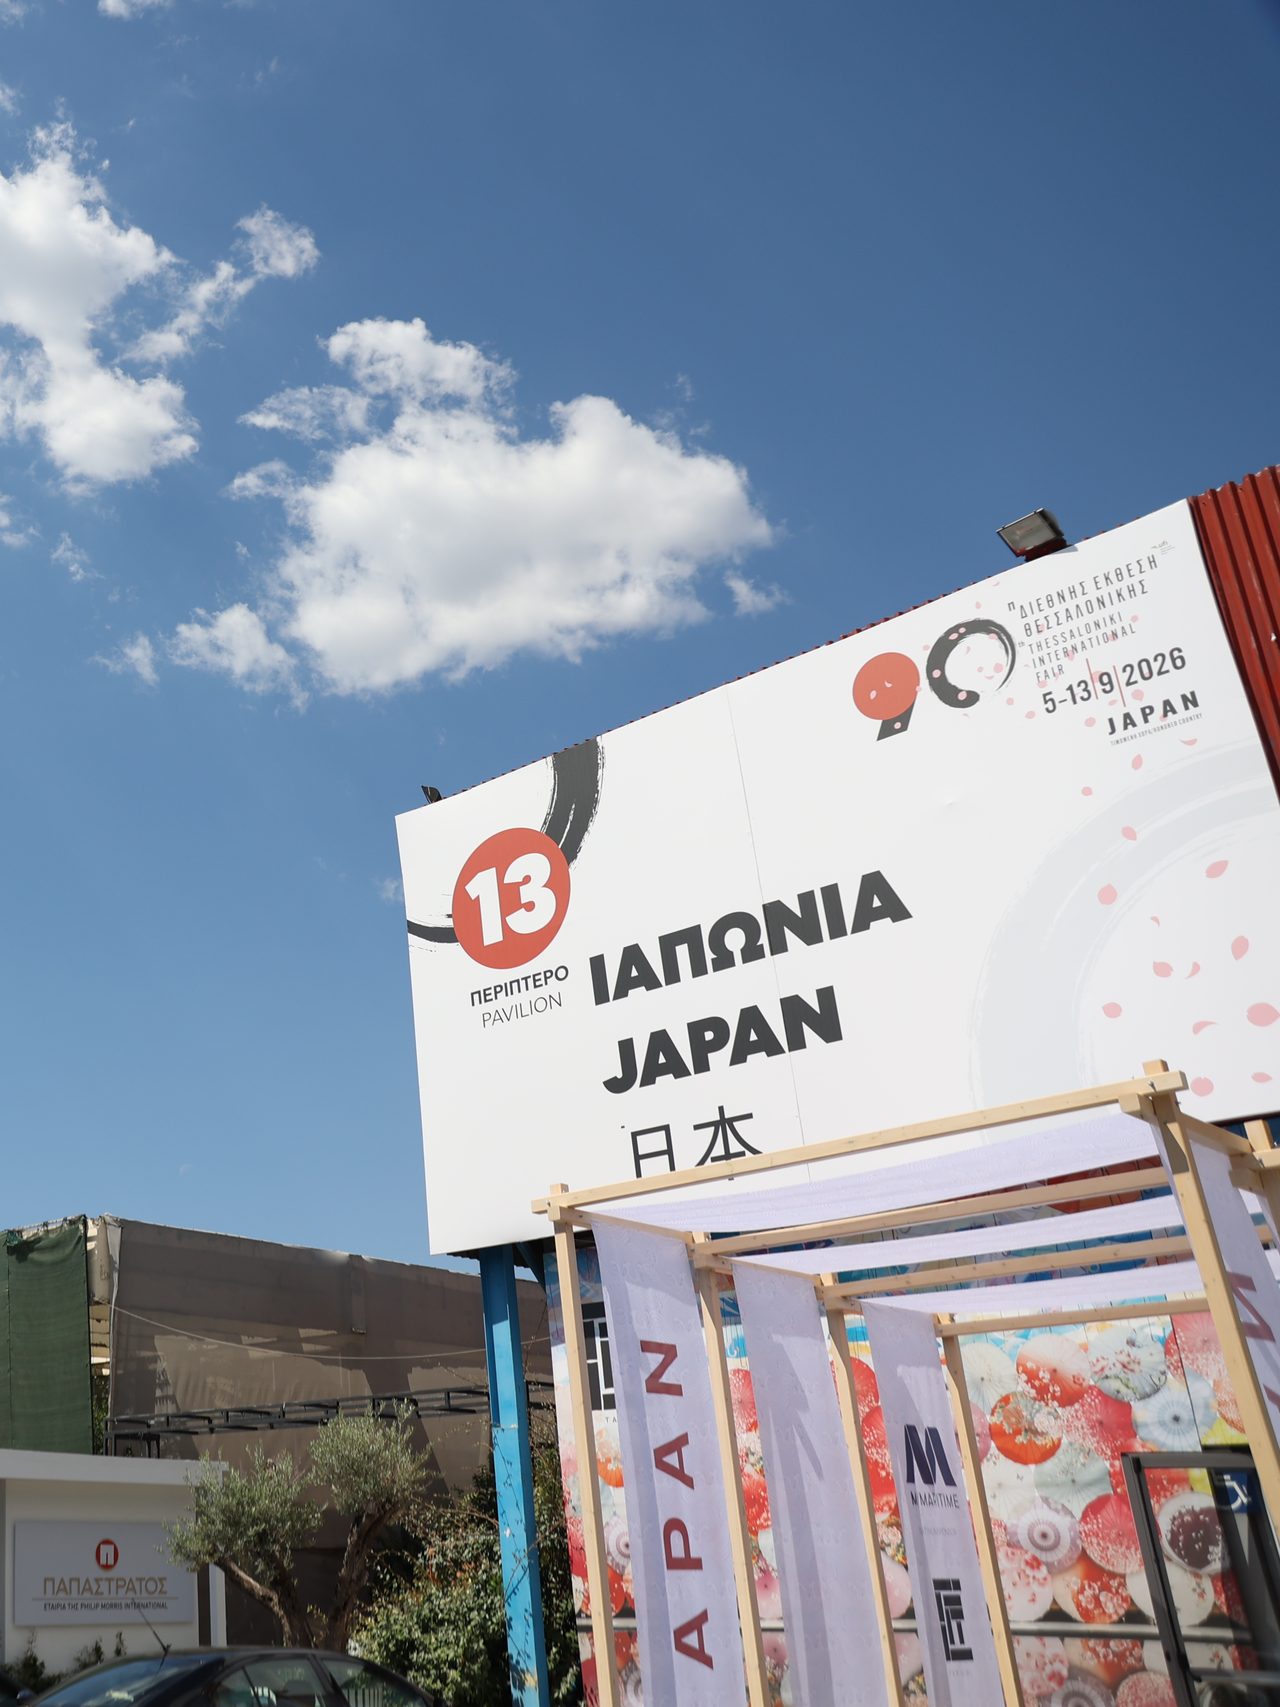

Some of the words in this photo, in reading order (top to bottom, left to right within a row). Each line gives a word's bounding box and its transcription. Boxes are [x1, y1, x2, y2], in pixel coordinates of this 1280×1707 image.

[1020, 581, 1088, 619] ΔΙΕΘΝΗΣ
[1093, 554, 1158, 591] ΕΚΘΕΣΗ
[1024, 579, 1148, 638] ΘΕΣΣΑΛΟΝΙΚΗΣ
[1028, 611, 1123, 655] THESSALONIKI
[1032, 623, 1136, 669] INTERNATIONAL
[1036, 664, 1065, 684] FAIR
[1108, 690, 1200, 736] JAPAN
[464, 852, 557, 947] 13
[589, 869, 914, 1006] ΙΑΠΩΝΙΑ
[470, 964, 569, 1007] ΠΕΡΙΠΤΕΡΟ
[482, 991, 562, 1029] PAVILION
[602, 985, 843, 1095] JAPAN
[630, 1105, 764, 1181] 日本
[43, 1577, 167, 1596] ΠΑΠΑΣΤΡΑΤΟΣ
[67, 1602, 79, 1611] ΤΗΣ
[80, 1602, 100, 1610] PHILIP
[100, 1601, 123, 1610] MORRIS
[124, 1600, 168, 1610] INTERNATIONAL
